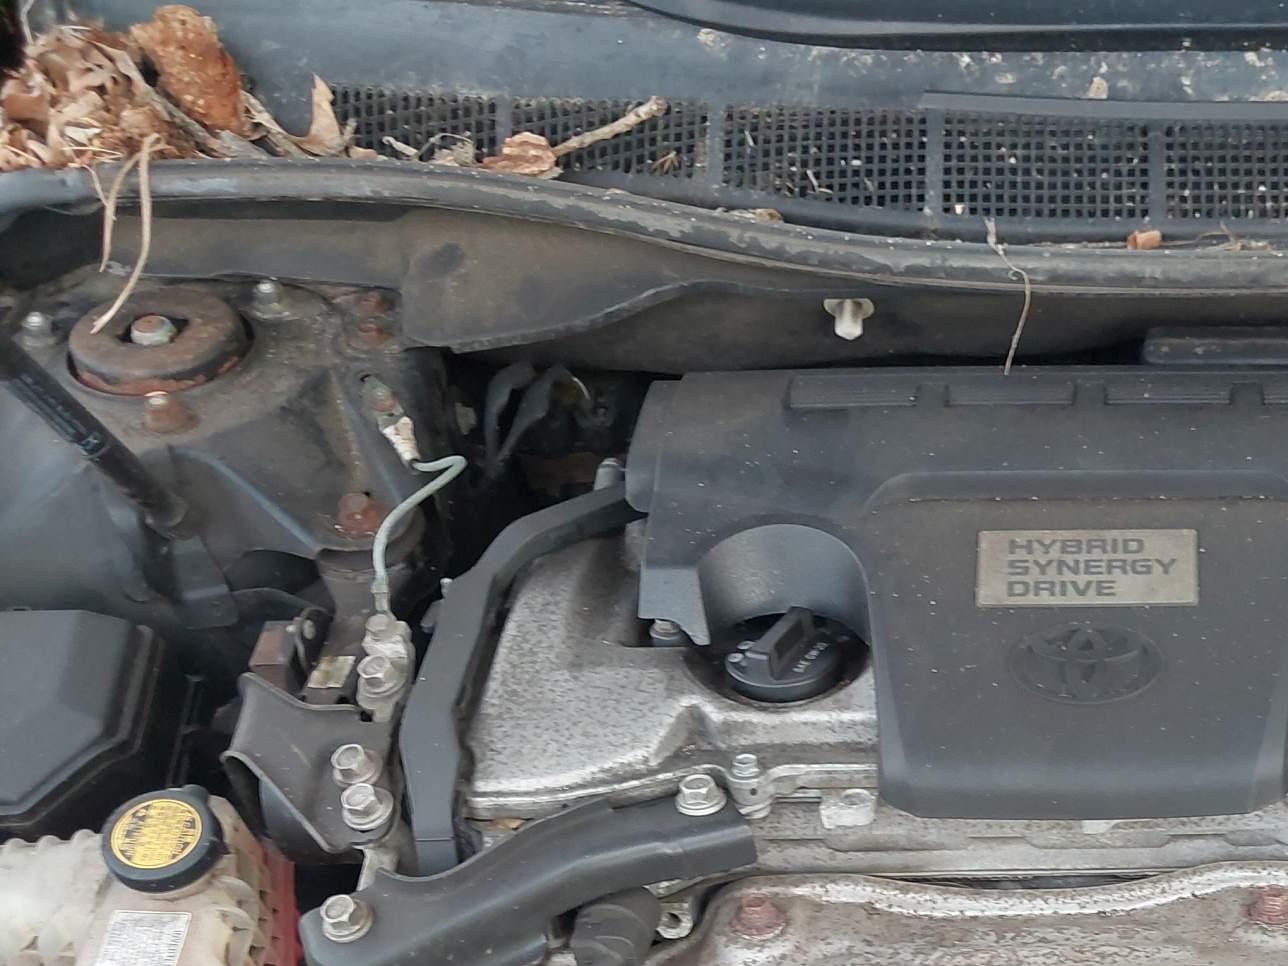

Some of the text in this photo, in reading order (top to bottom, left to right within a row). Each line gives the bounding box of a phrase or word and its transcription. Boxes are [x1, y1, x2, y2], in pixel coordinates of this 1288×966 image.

[1008, 538, 1145, 555] HYBRID
[1007, 558, 1177, 576] SYNERGY
[1007, 579, 1117, 597] DRIVE
